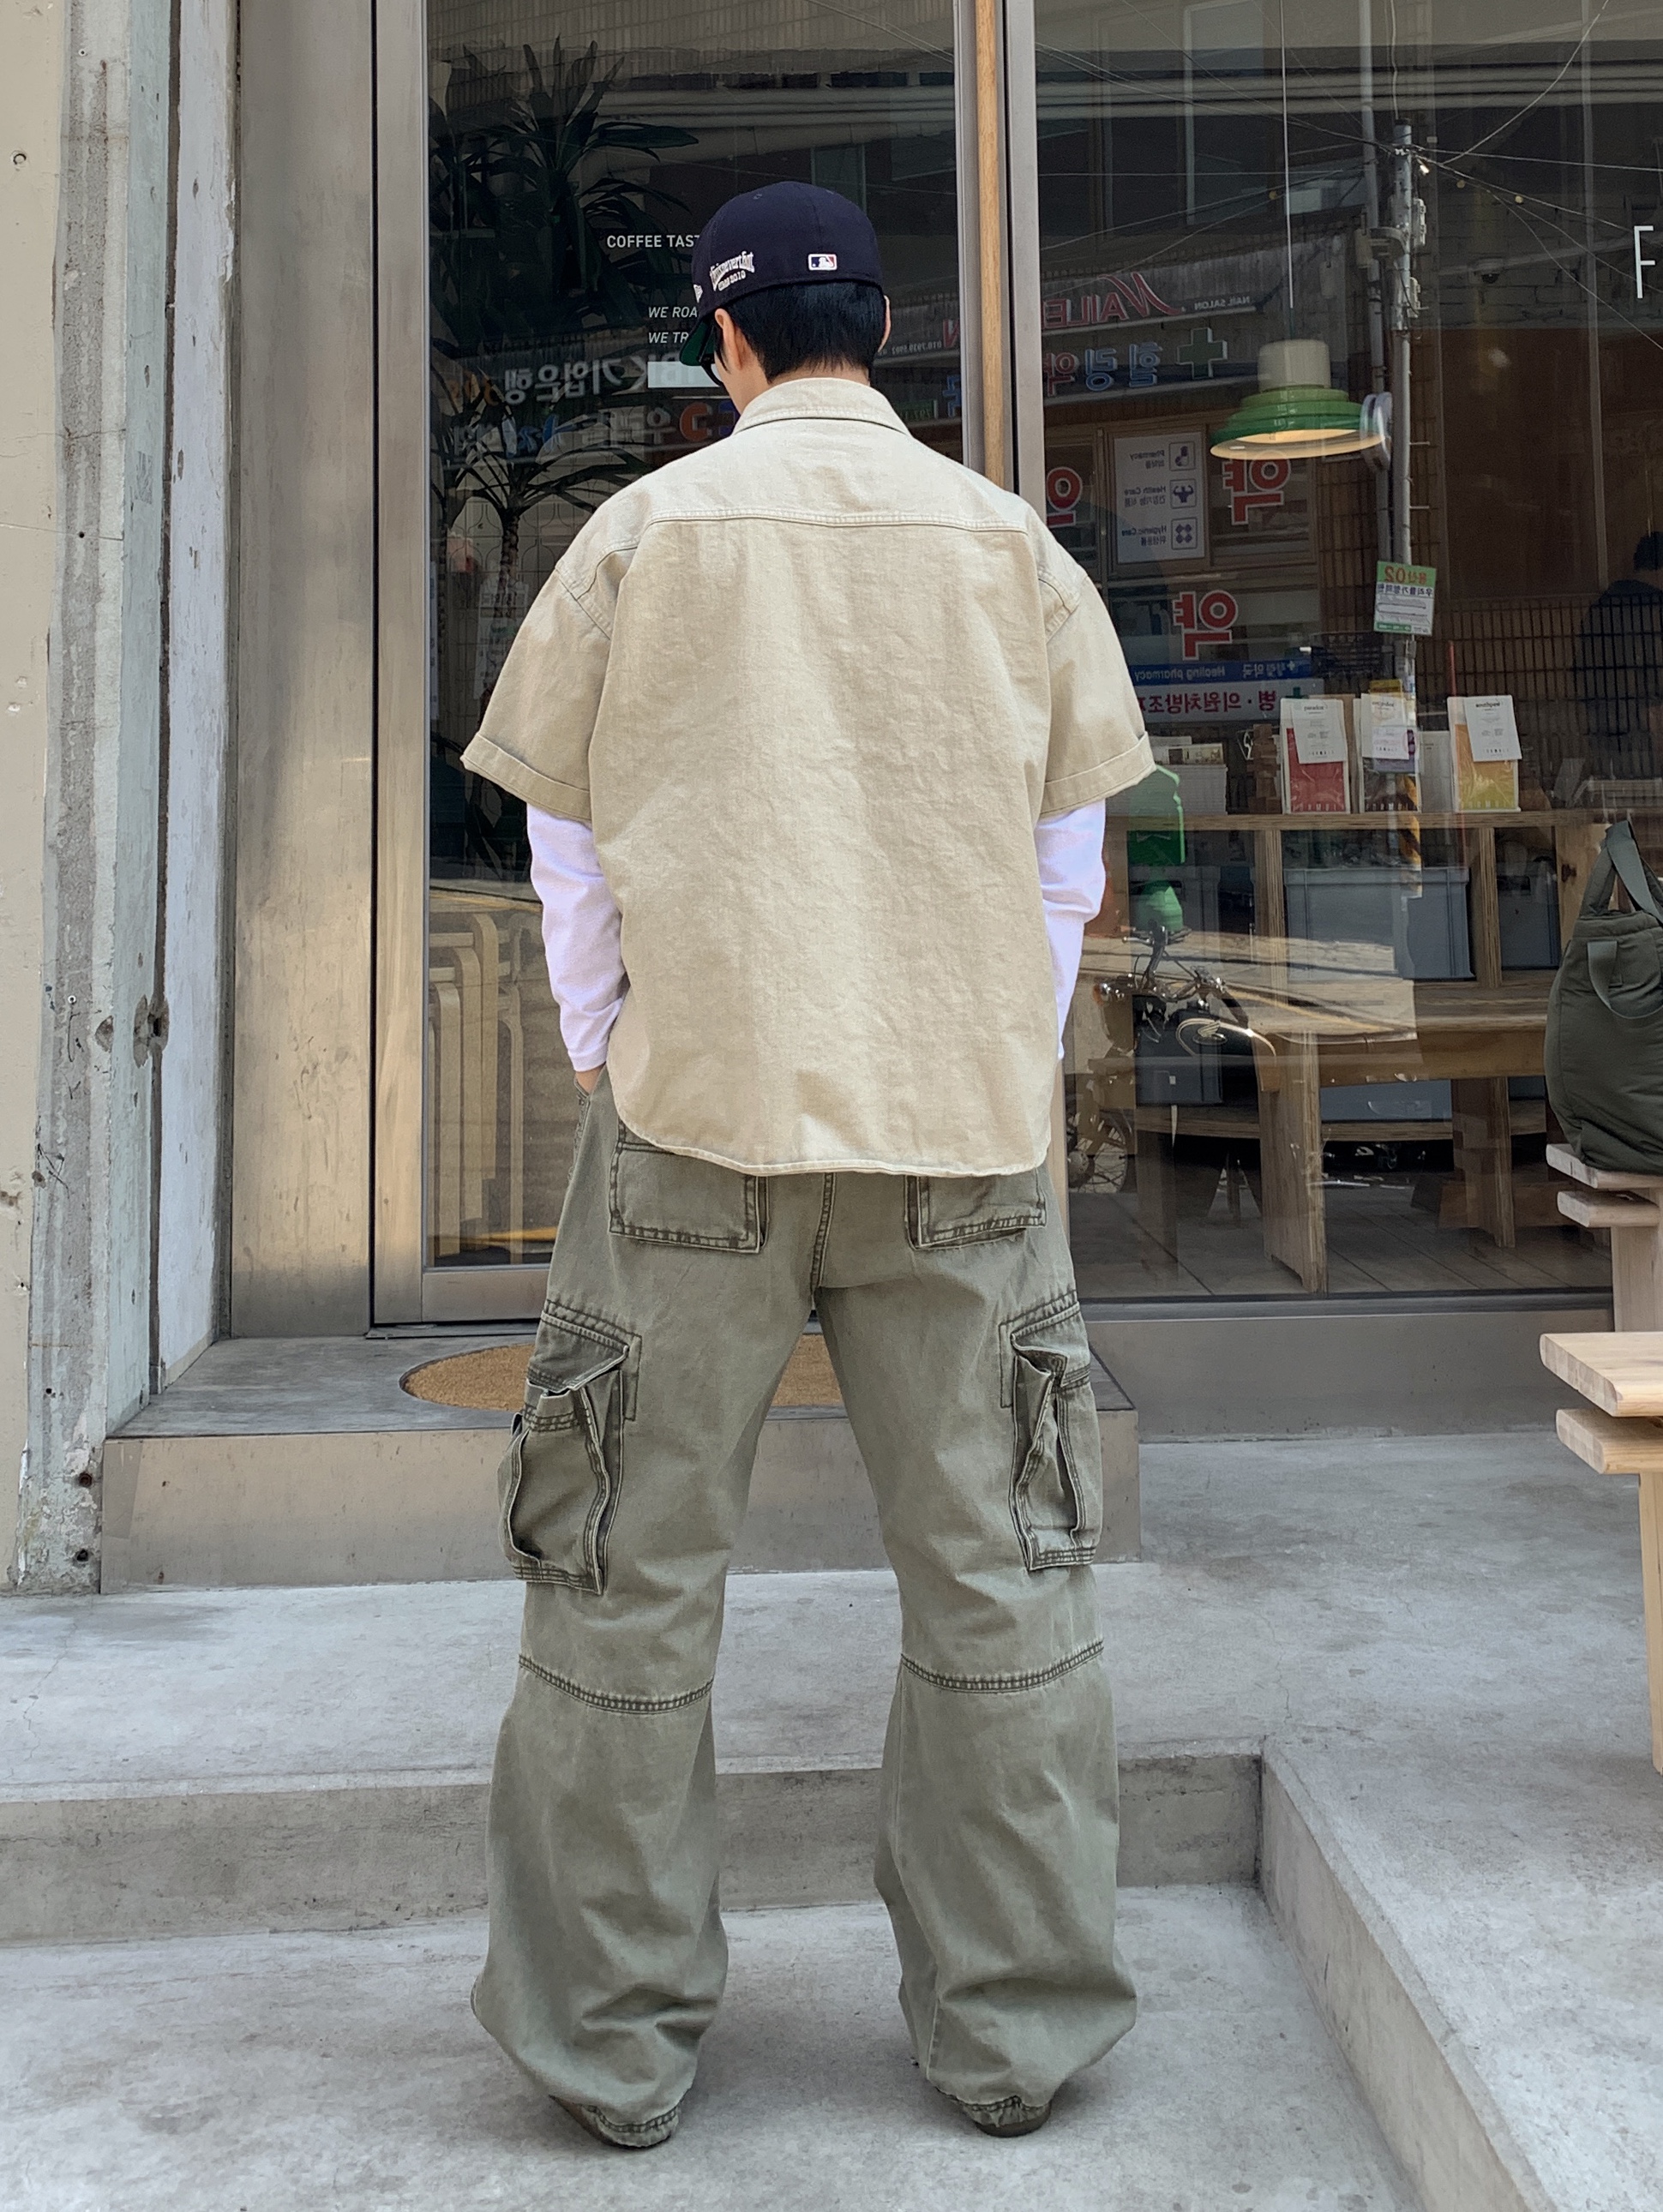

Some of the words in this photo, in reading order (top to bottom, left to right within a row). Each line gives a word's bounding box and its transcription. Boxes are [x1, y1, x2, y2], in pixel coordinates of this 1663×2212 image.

[606, 235, 663, 248] COFFEE
[1634, 225, 1655, 298] F
[648, 307, 669, 318] WE
[672, 307, 699, 318] ROA
[648, 332, 669, 344] WE
